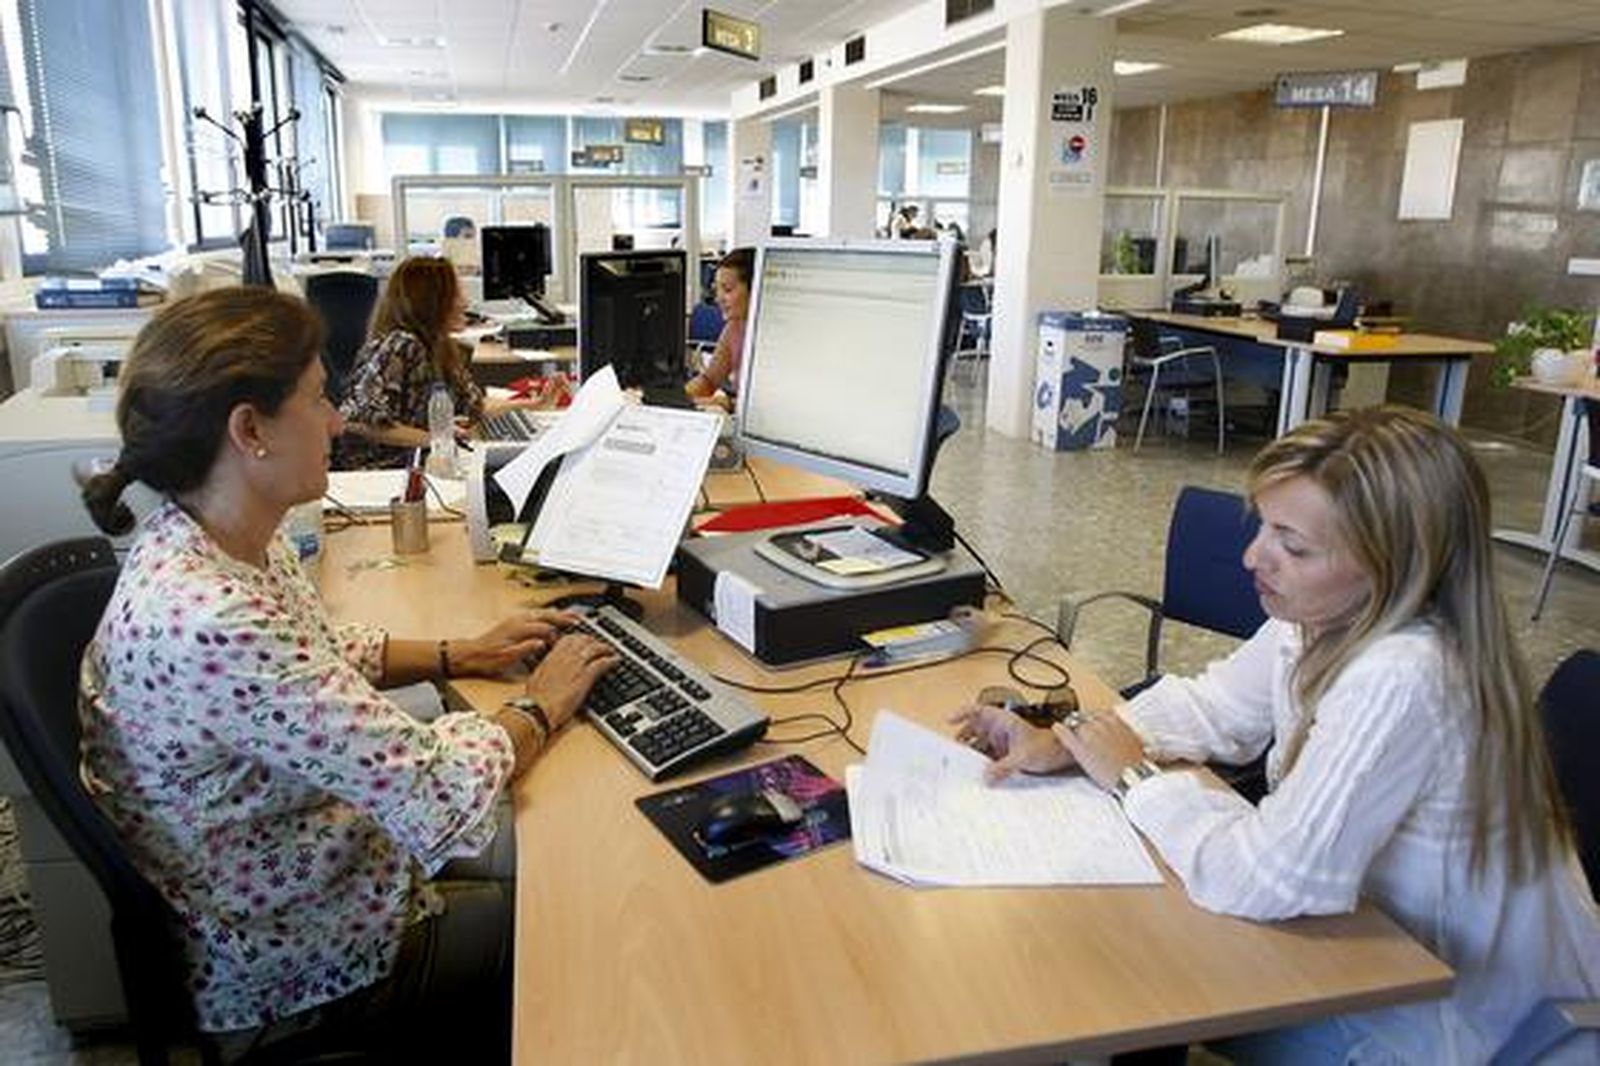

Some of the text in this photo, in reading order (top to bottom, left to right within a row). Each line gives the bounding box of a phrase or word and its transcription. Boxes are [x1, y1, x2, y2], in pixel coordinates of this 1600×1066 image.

[1081, 86, 1098, 105] 16
[1291, 77, 1370, 102] MESA 14
